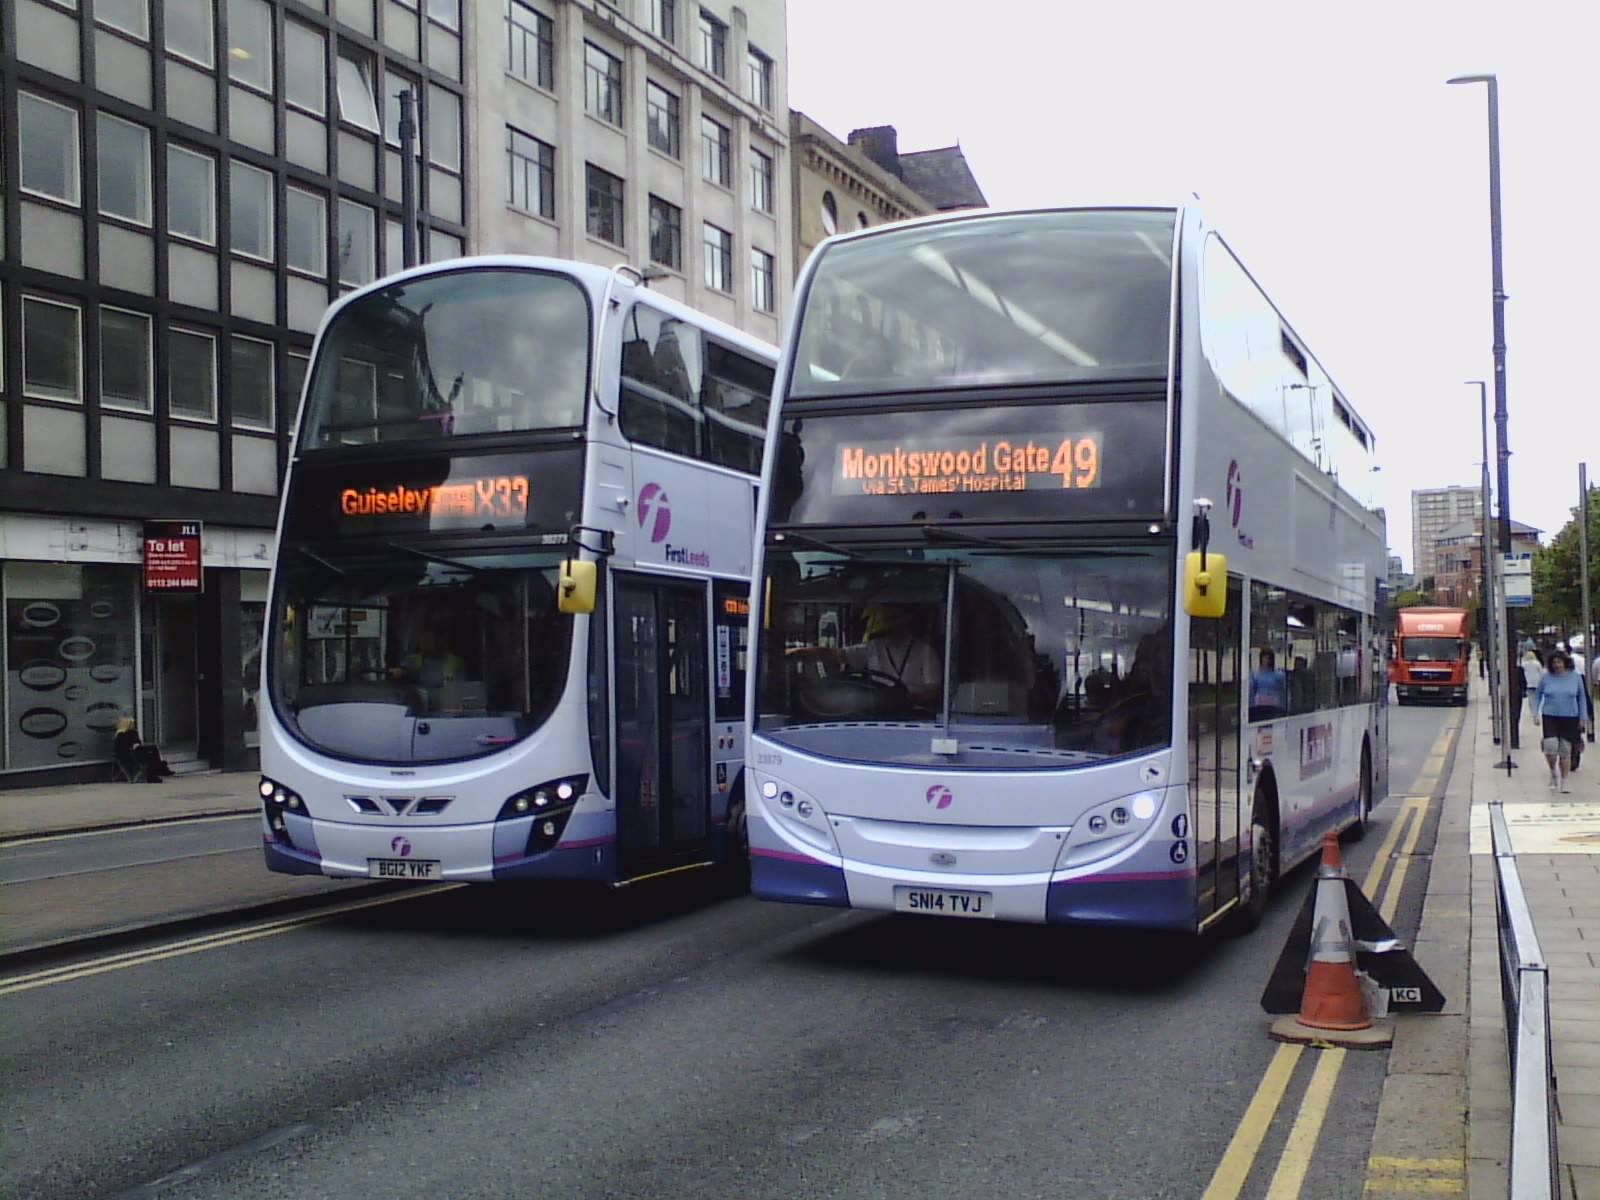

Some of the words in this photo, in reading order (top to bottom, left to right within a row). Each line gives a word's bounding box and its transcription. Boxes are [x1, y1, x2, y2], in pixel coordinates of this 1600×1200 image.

[842, 442, 988, 478] Monkswood
[993, 440, 1049, 473] Gate
[1051, 438, 1098, 488] 49
[962, 473, 1026, 491] Hospital
[341, 486, 430, 515] Guiseley
[475, 474, 529, 517] X33
[147, 540, 165, 552] To
[168, 540, 185, 552] let
[379, 862, 407, 877] BG12
[409, 864, 433, 878] YKF
[909, 891, 945, 911] SN14
[949, 894, 983, 914] TVJ
[1396, 989, 1418, 1001] KC
